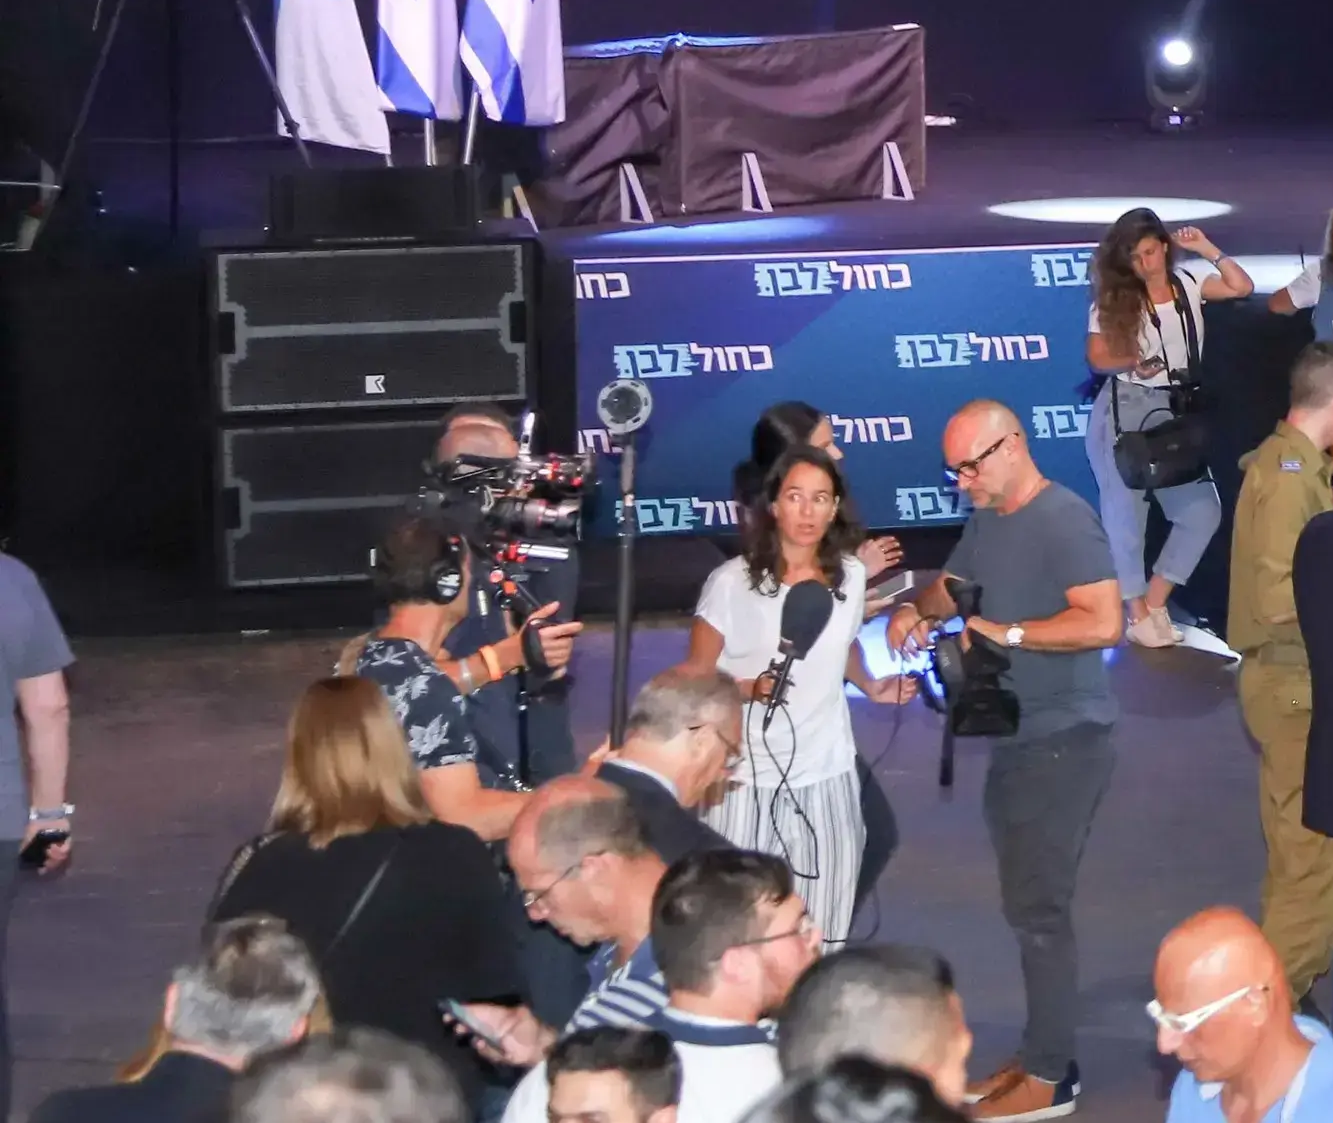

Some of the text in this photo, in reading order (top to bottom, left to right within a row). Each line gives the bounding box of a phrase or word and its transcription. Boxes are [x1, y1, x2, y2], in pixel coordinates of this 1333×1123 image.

[576, 272, 631, 299] כחו
[829, 260, 913, 291] כחול
[689, 343, 774, 373] כחול
[968, 332, 1050, 362] כחול
[830, 414, 914, 444] כחול
